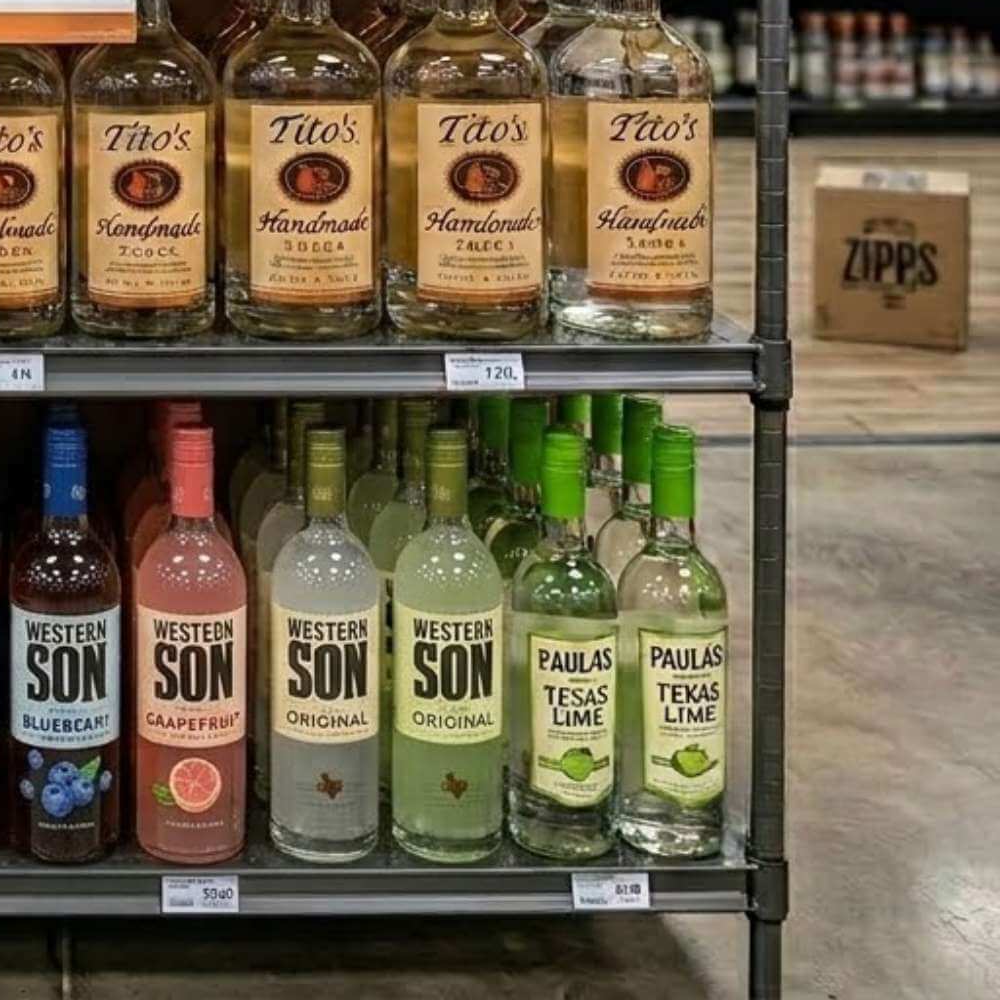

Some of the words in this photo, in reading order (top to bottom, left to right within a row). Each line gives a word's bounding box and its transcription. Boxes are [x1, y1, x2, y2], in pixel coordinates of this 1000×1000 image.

[842, 236, 939, 288] ZIPPS
[25, 619, 107, 644] WESTERN
[287, 616, 368, 642] WESTERN
[413, 617, 493, 642] WESTERN
[26, 640, 107, 703] SON
[153, 640, 234, 702] SON
[287, 639, 368, 702] SON
[413, 639, 494, 702] SON
[538, 647, 613, 673] PAULAS
[552, 706, 605, 728] LIME
